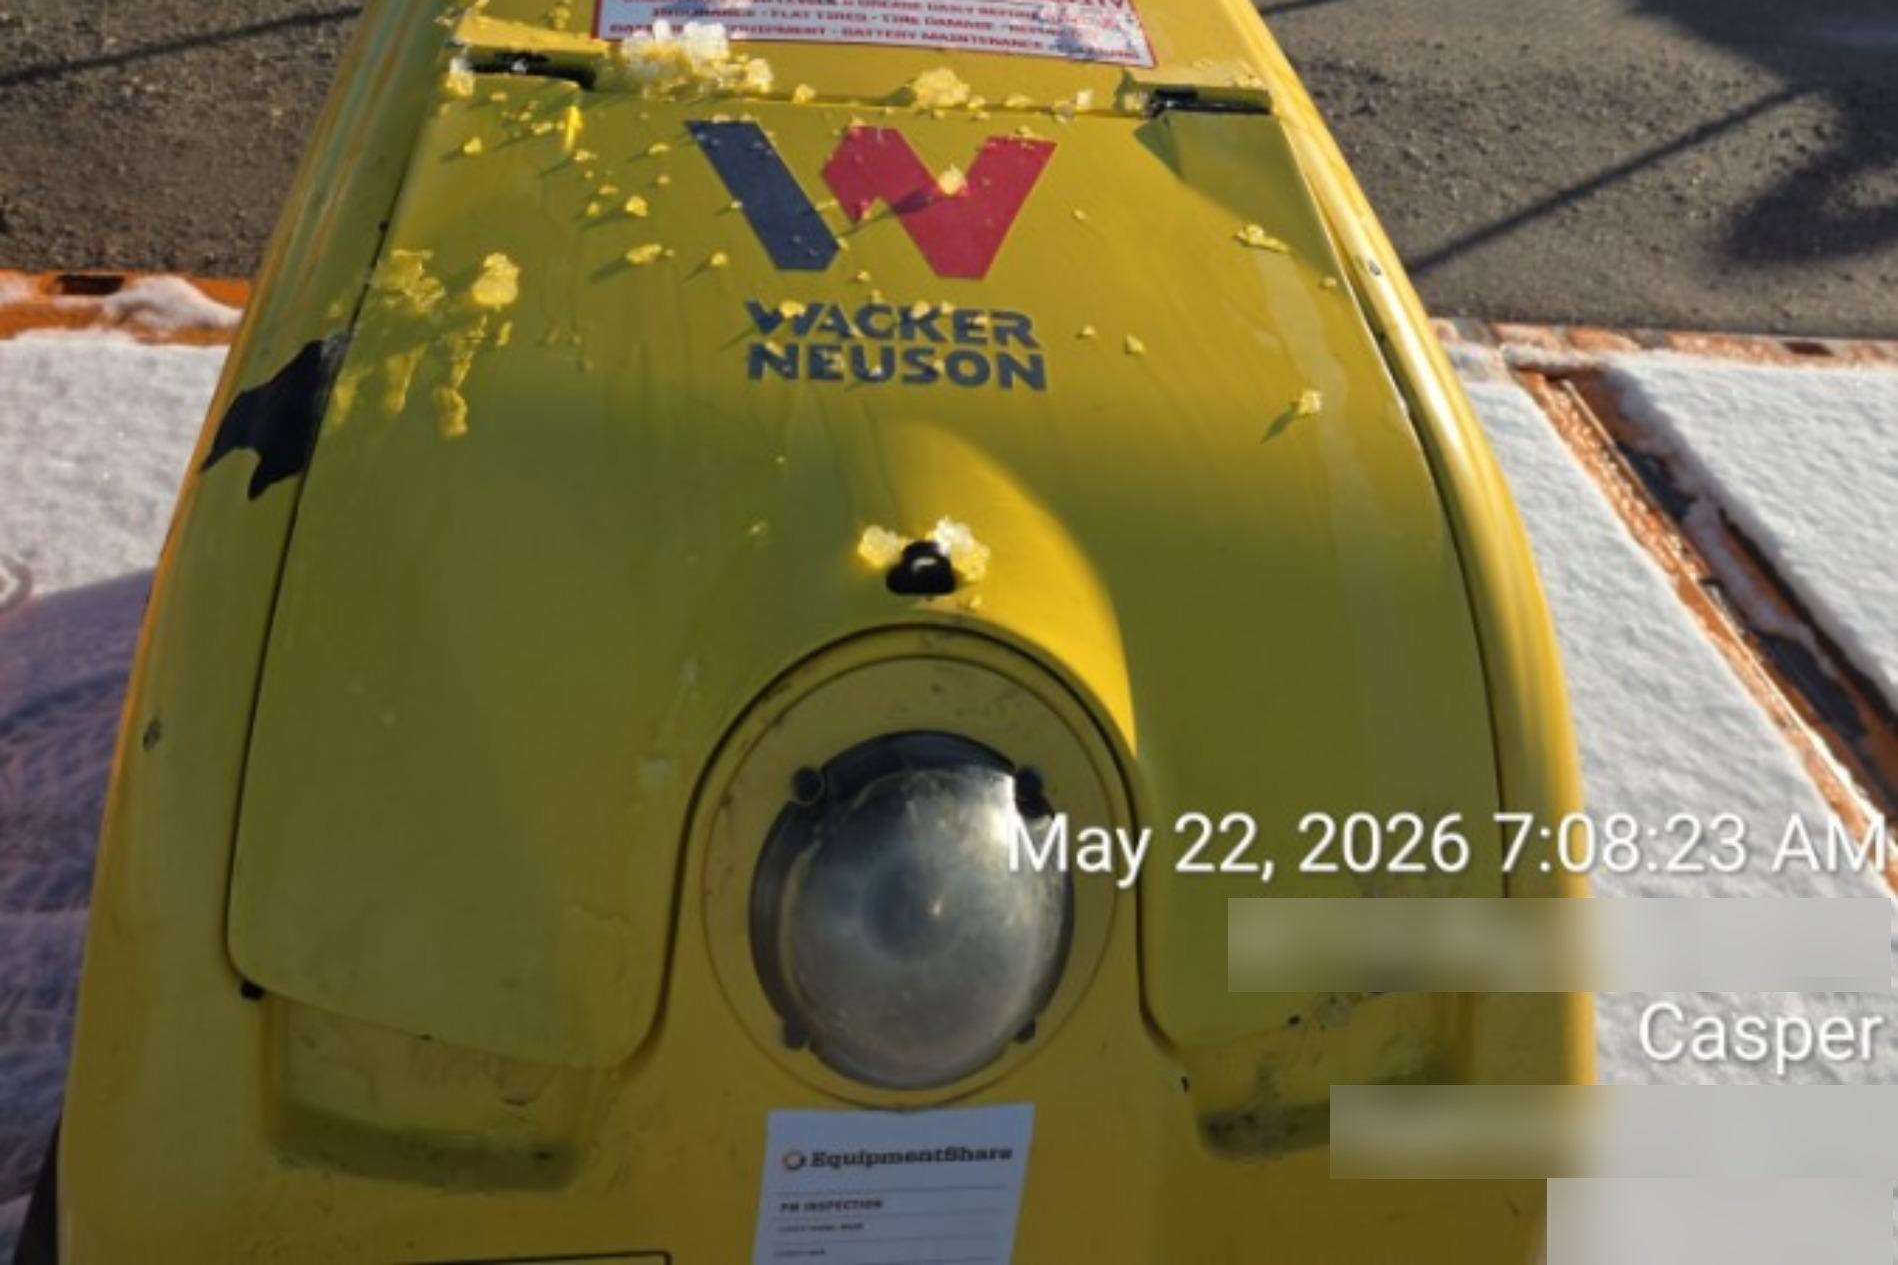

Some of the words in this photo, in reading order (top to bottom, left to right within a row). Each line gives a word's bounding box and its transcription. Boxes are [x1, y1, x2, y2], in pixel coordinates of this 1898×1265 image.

[745, 300, 1040, 349] WACKER
[747, 342, 1046, 391] NEUSON
[810, 1145, 1013, 1170] EquipmentShare
[804, 1198, 884, 1213] INSPECTION
